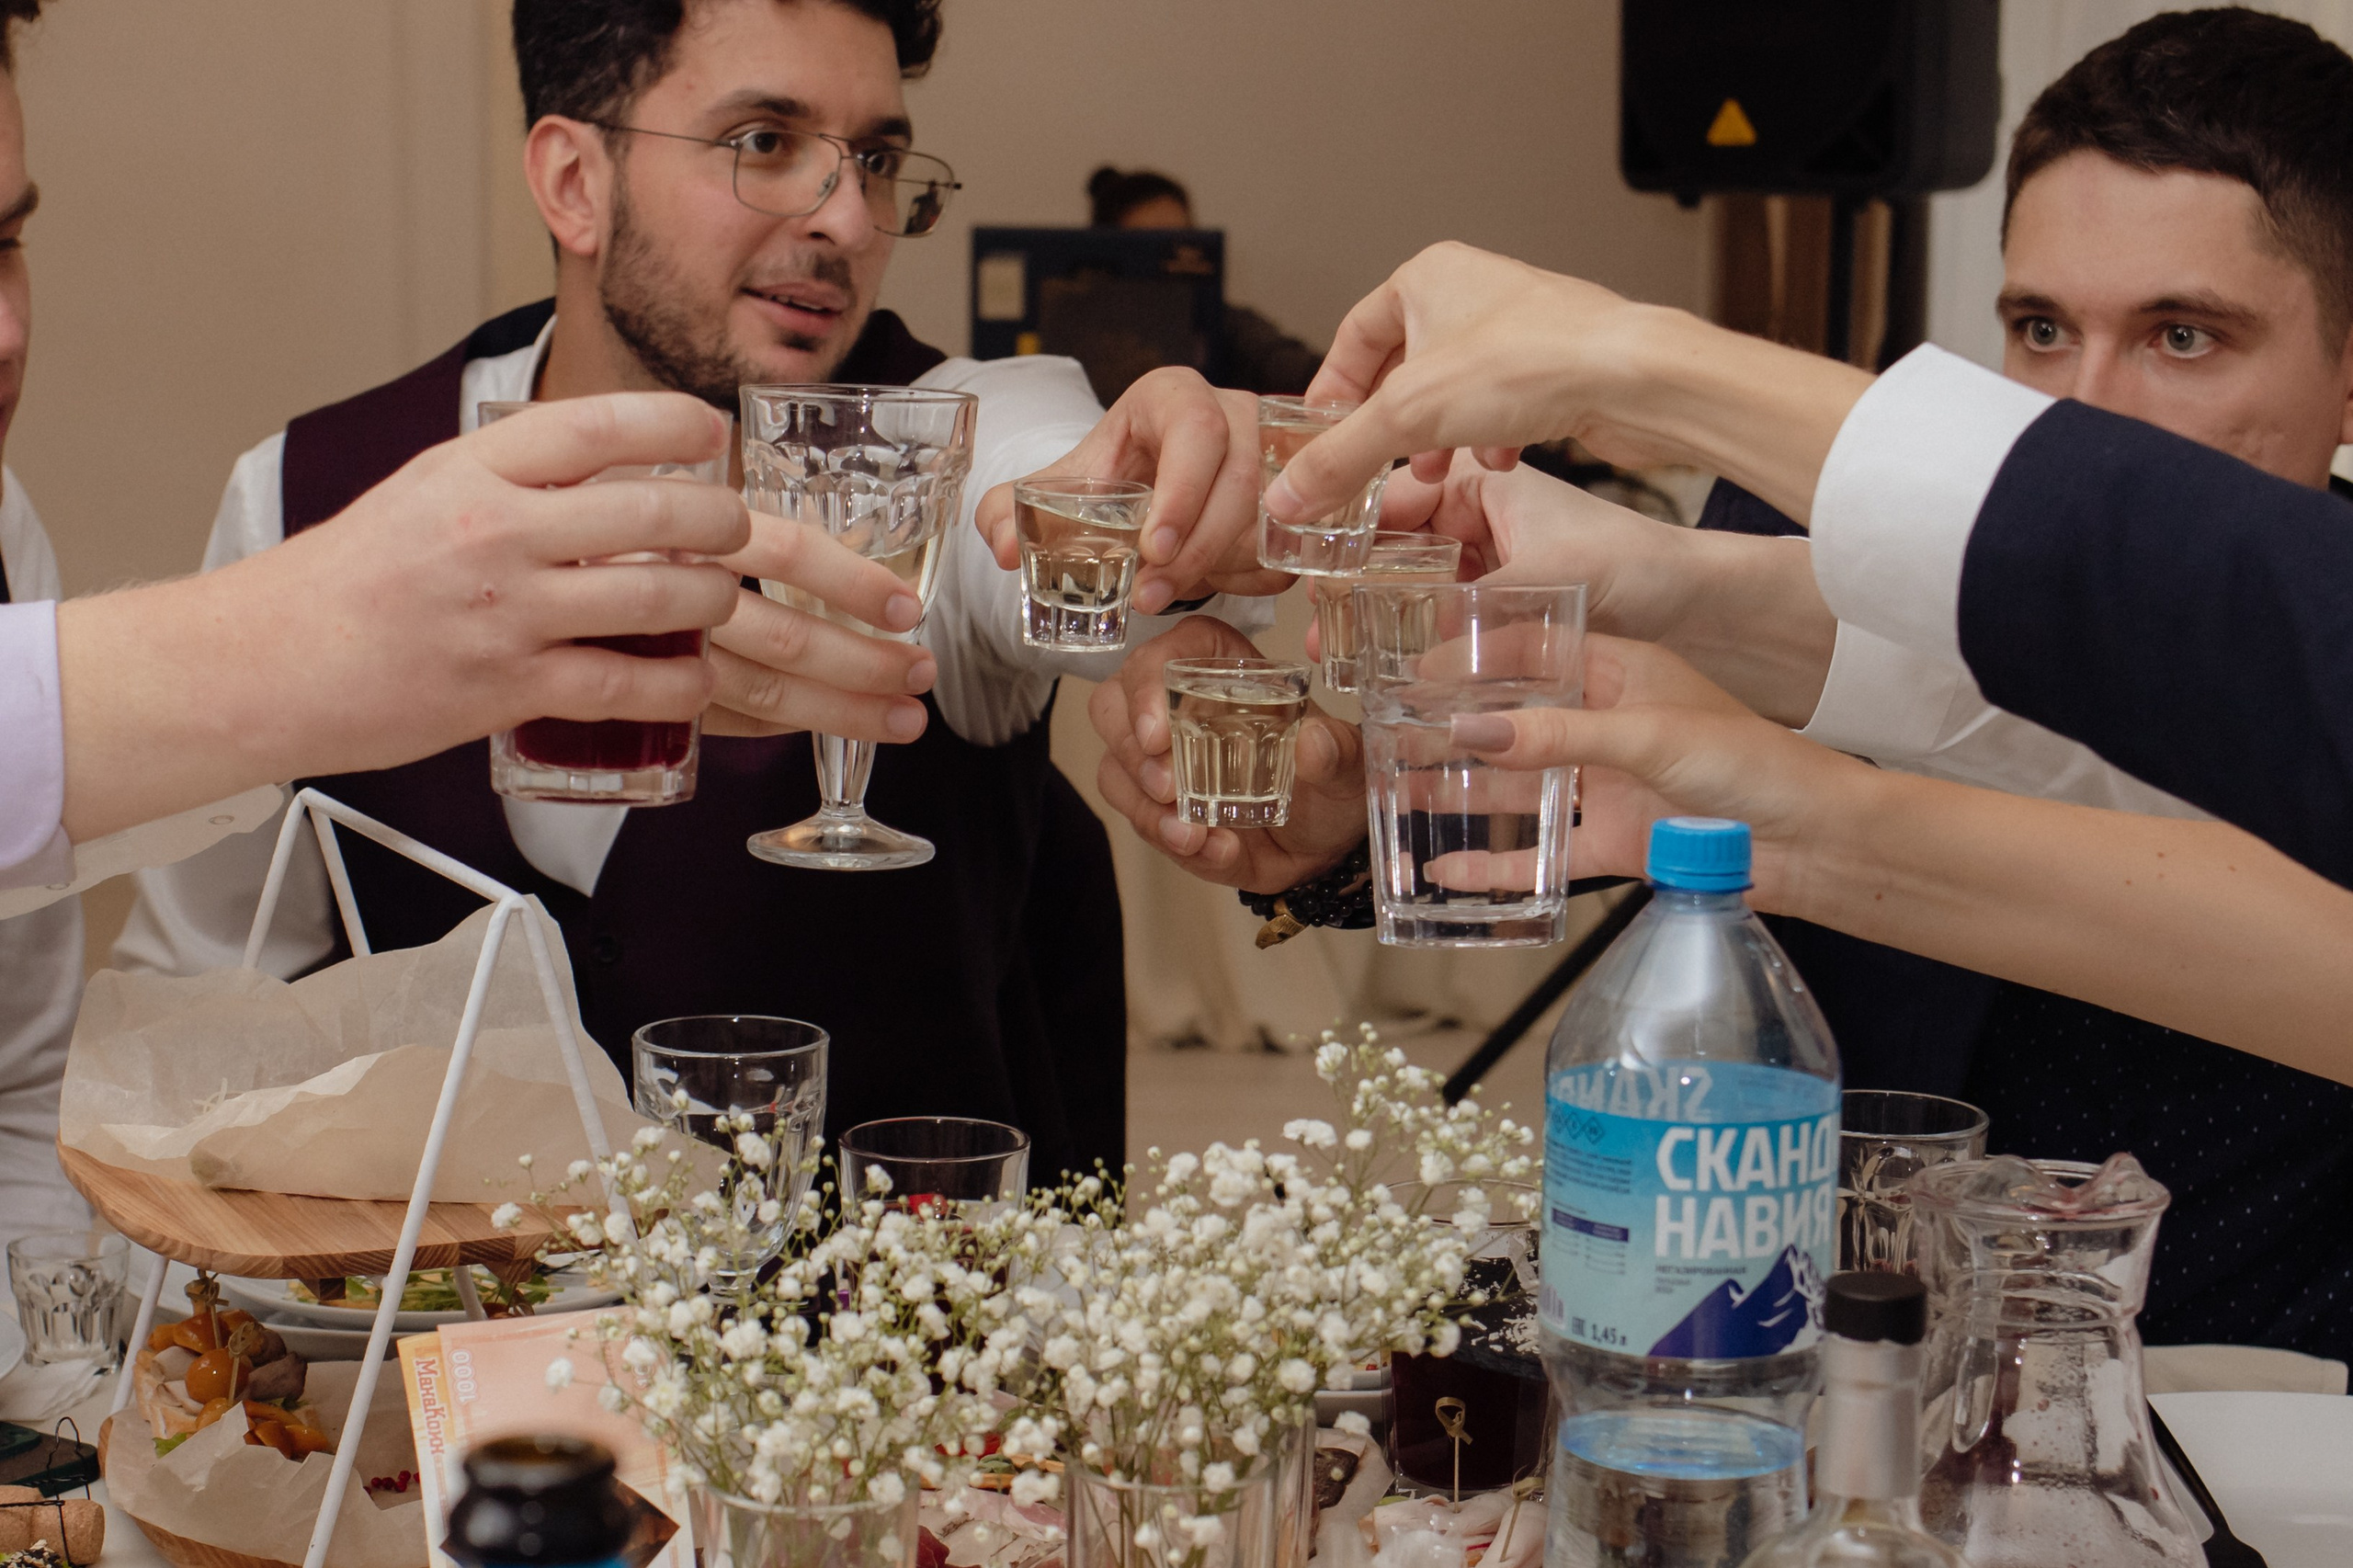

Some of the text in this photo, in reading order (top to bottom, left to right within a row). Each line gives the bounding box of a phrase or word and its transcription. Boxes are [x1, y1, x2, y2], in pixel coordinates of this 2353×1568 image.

[1656, 1116, 1836, 1191] СКАНД
[1654, 1183, 1829, 1259] НАВИЯ
[451, 1349, 477, 1403] 1000
